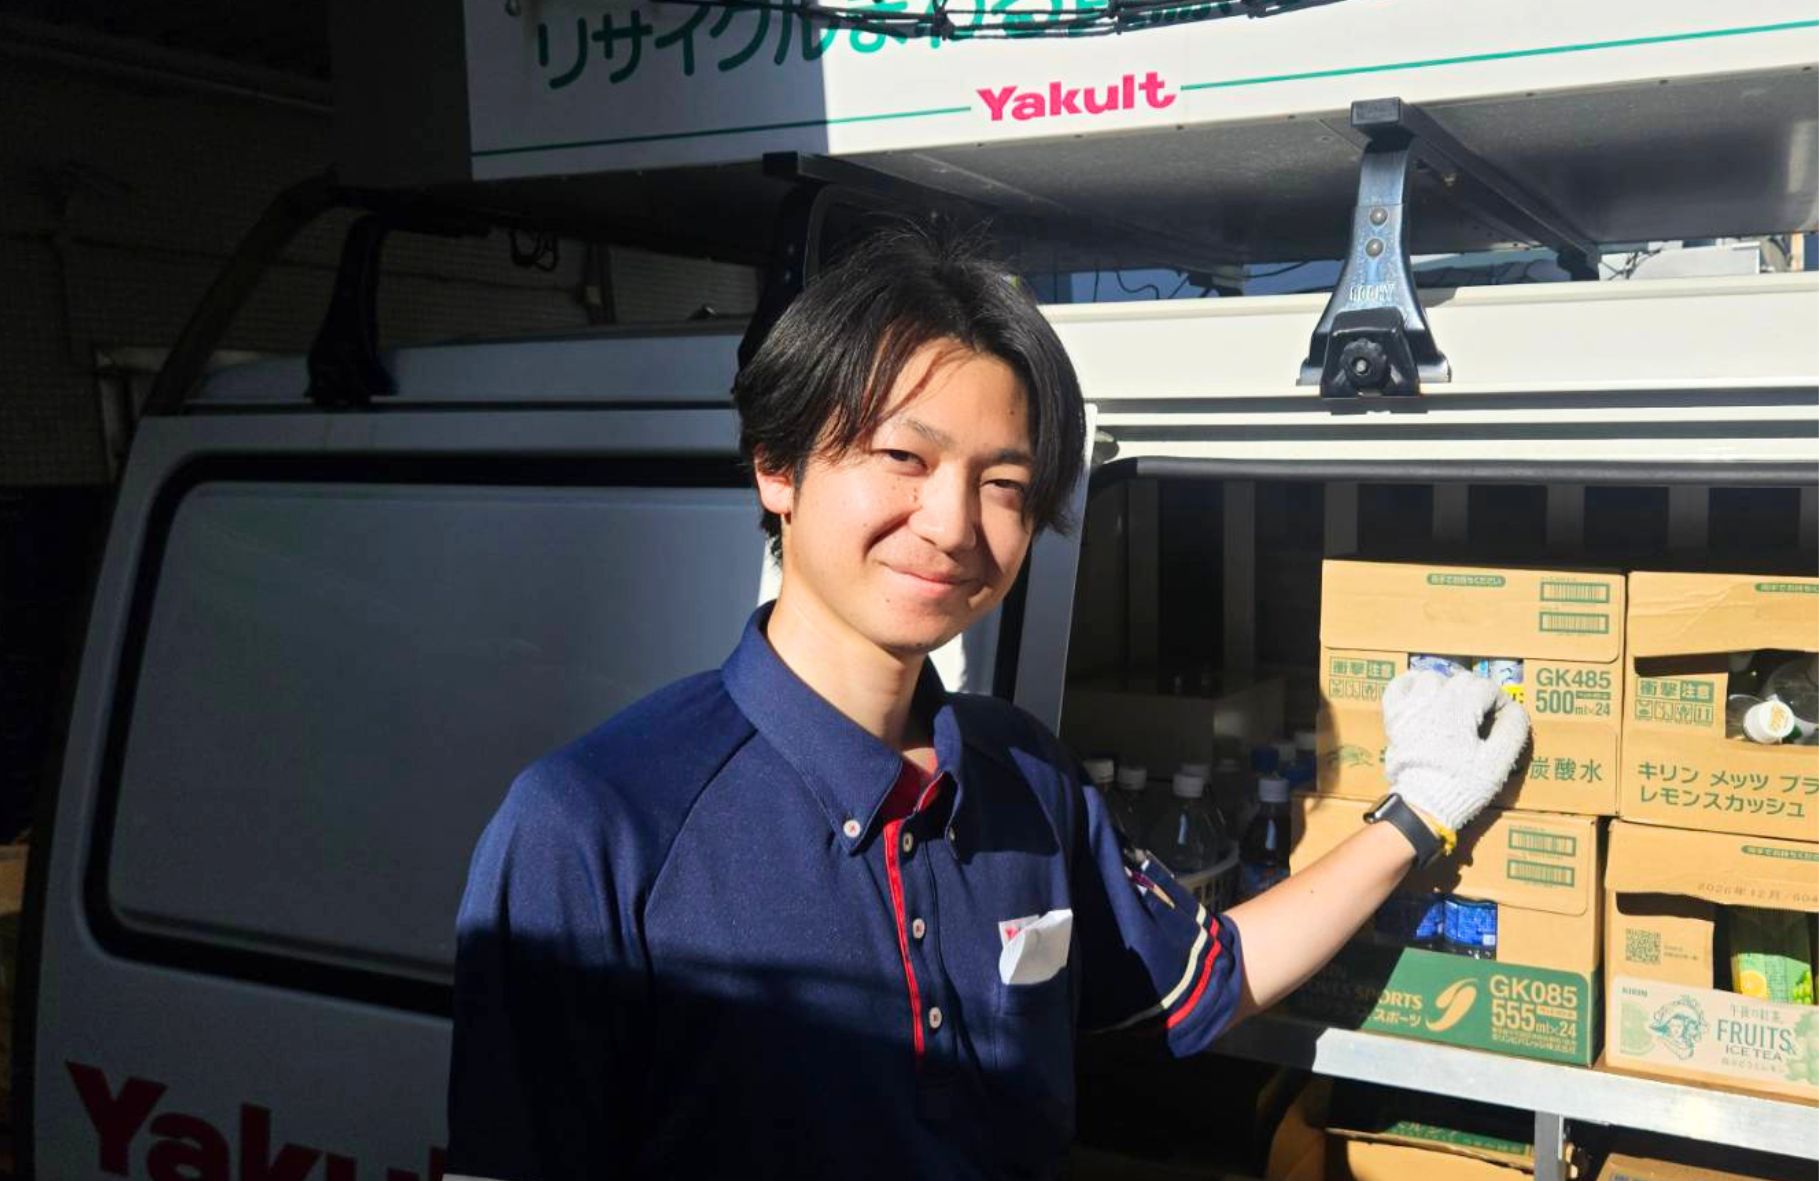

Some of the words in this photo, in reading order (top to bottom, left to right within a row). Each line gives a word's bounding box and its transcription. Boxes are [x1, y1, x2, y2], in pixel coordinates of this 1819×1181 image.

[976, 72, 1176, 122] Yakult
[1535, 667, 1612, 689] GK485
[1530, 757, 1603, 783] 炭酸水
[1637, 761, 1699, 784] キリン
[1710, 769, 1769, 791] メッツ
[1640, 785, 1806, 819] レモンスカッシュ
[1489, 974, 1577, 1009] GK085
[1716, 1019, 1792, 1053] FRUITS
[1725, 1045, 1752, 1057] ICE
[1754, 1048, 1783, 1062] TEA
